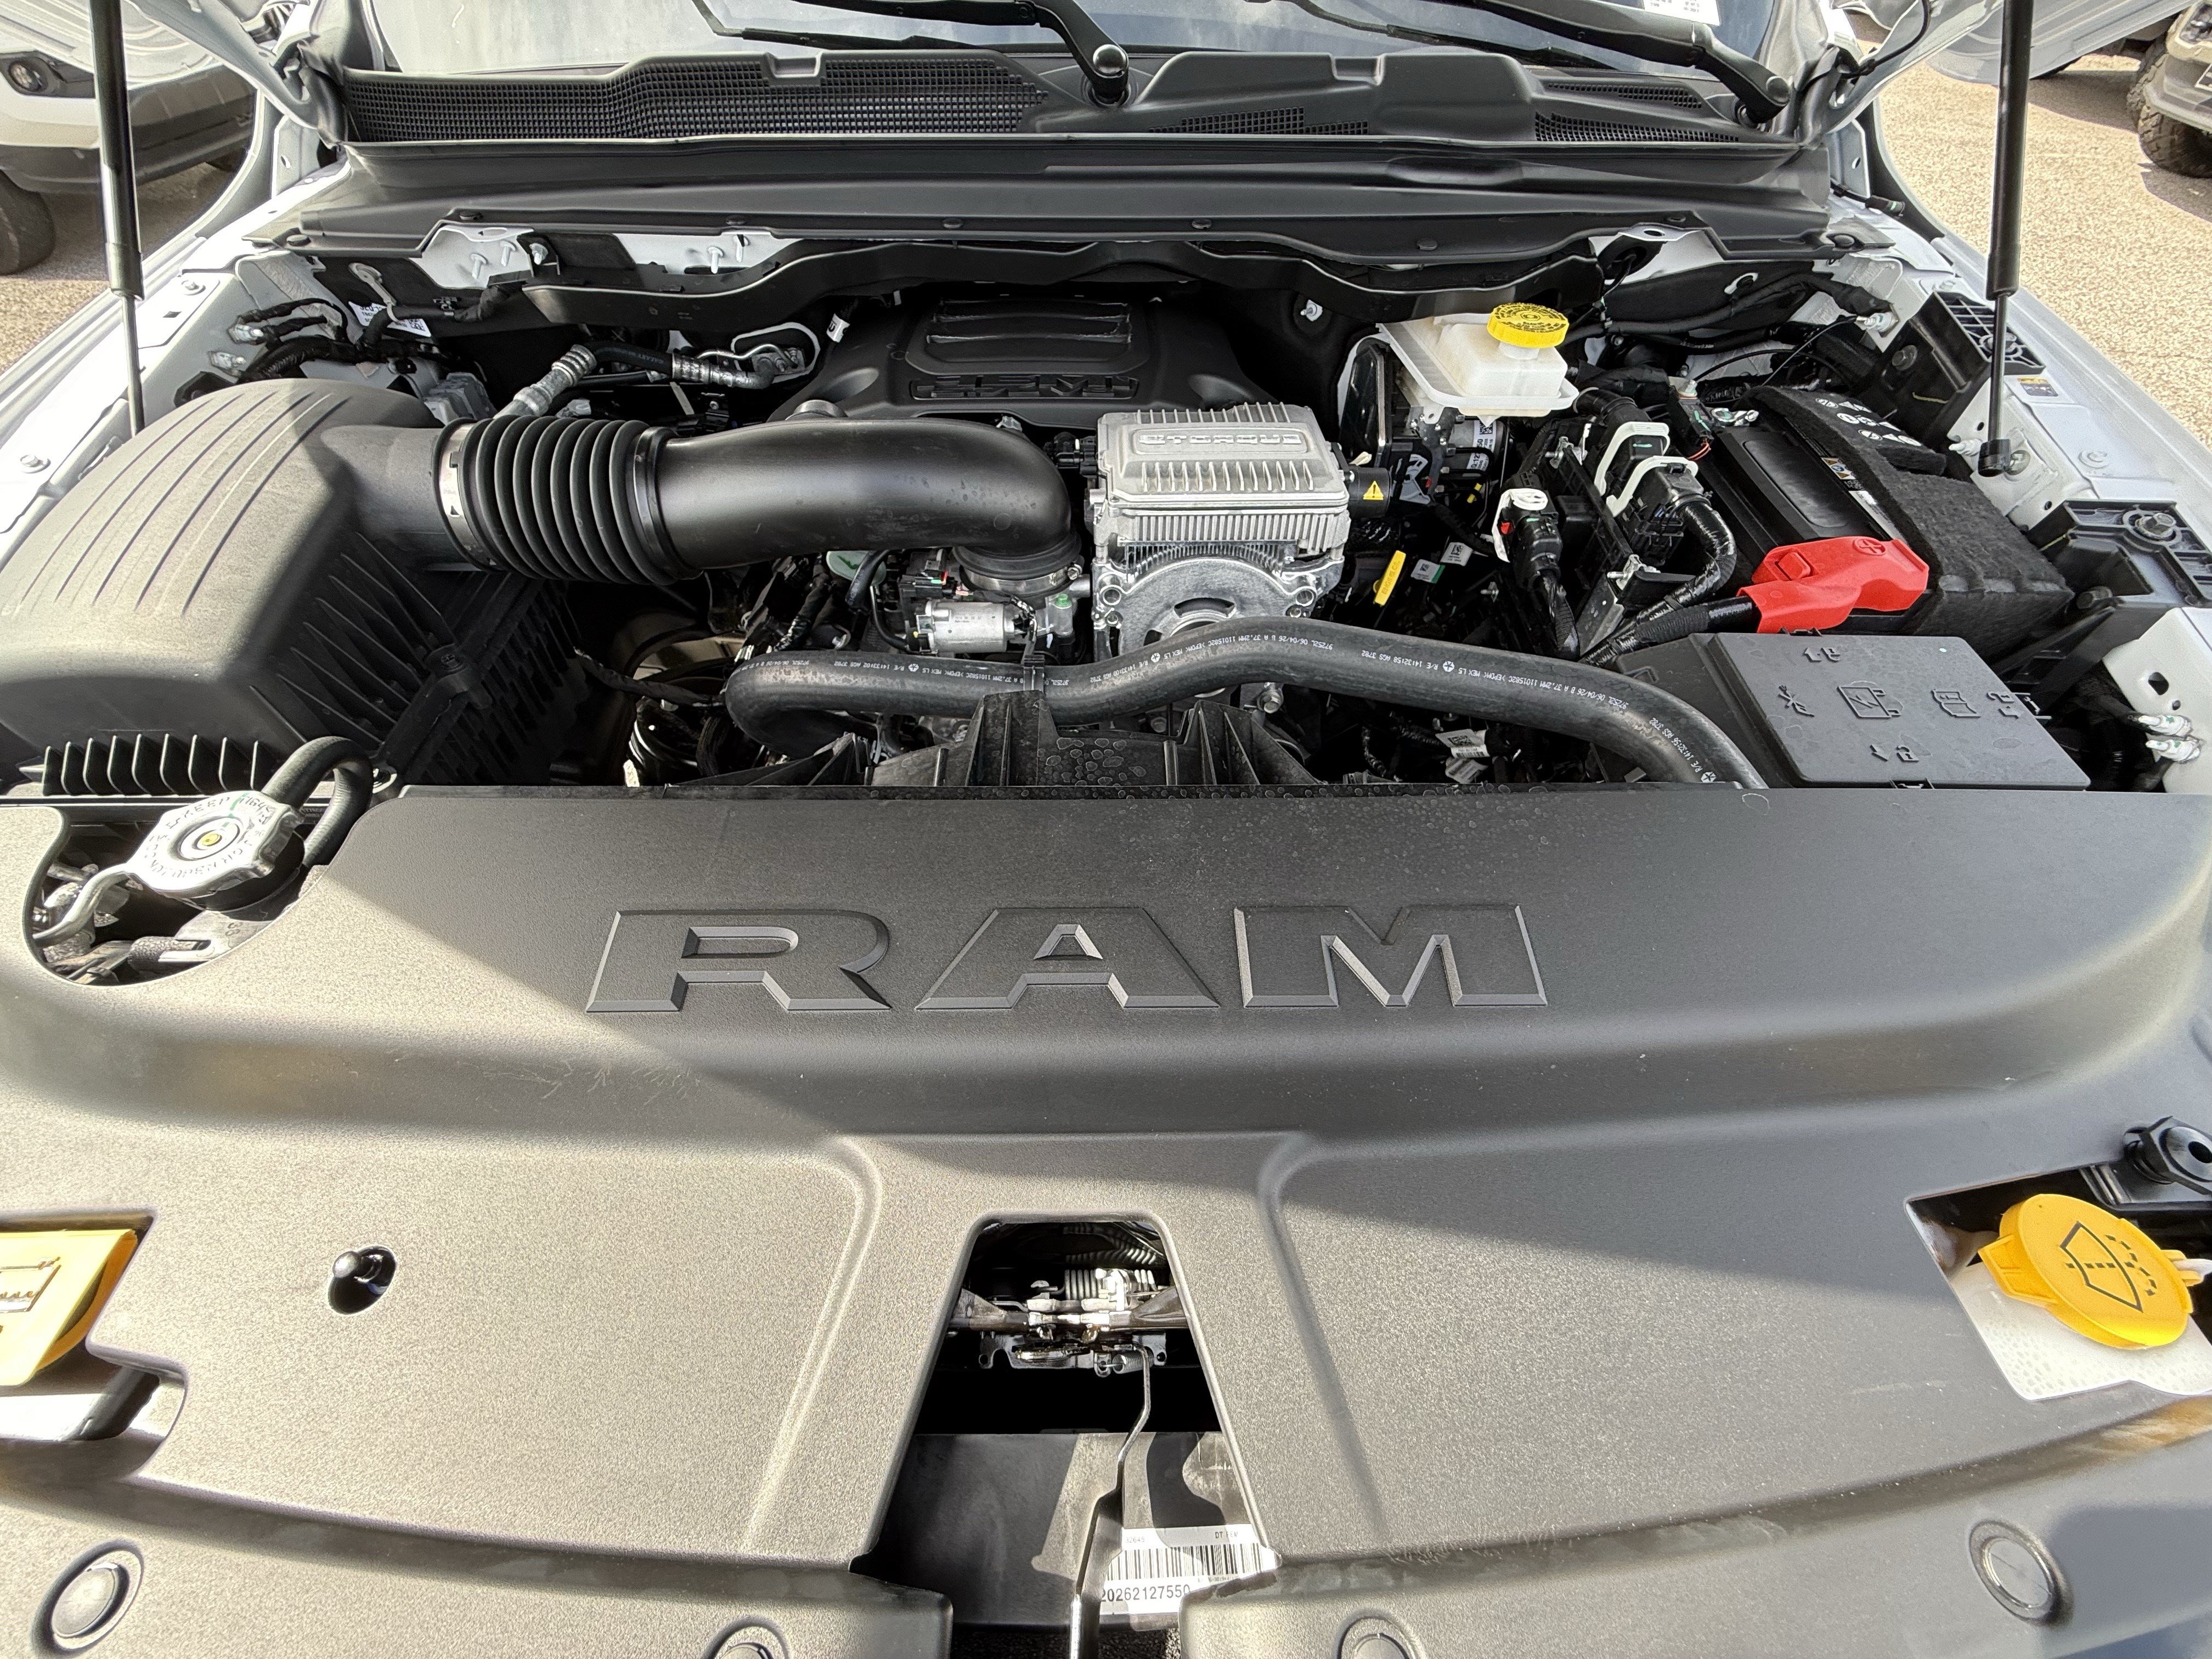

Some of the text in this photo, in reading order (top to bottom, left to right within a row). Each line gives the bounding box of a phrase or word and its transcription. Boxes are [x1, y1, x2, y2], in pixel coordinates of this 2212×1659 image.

[1207, 636, 1235, 647] 1101582C
[1279, 636, 1308, 645] 06/04/26
[1311, 640, 1333, 650] 97252L
[1361, 650, 1376, 659] 3782
[1393, 656, 1423, 668] 14:32:58
[1426, 662, 1438, 670] R/E
[966, 672, 991, 680] 1101582C
[1468, 669, 1481, 678] MEX
[1508, 675, 1538, 687] 1101582C
[1539, 680, 1562, 691] 37.2MM
[1577, 688, 1606, 701] 06/04/26
[1609, 696, 1629, 709] 97252L
[1649, 717, 1703, 772] R/E 14:32:56 AGS 3782
[586, 906, 1547, 1011] RAM
[1102, 1584, 1190, 1602] 20262127550
